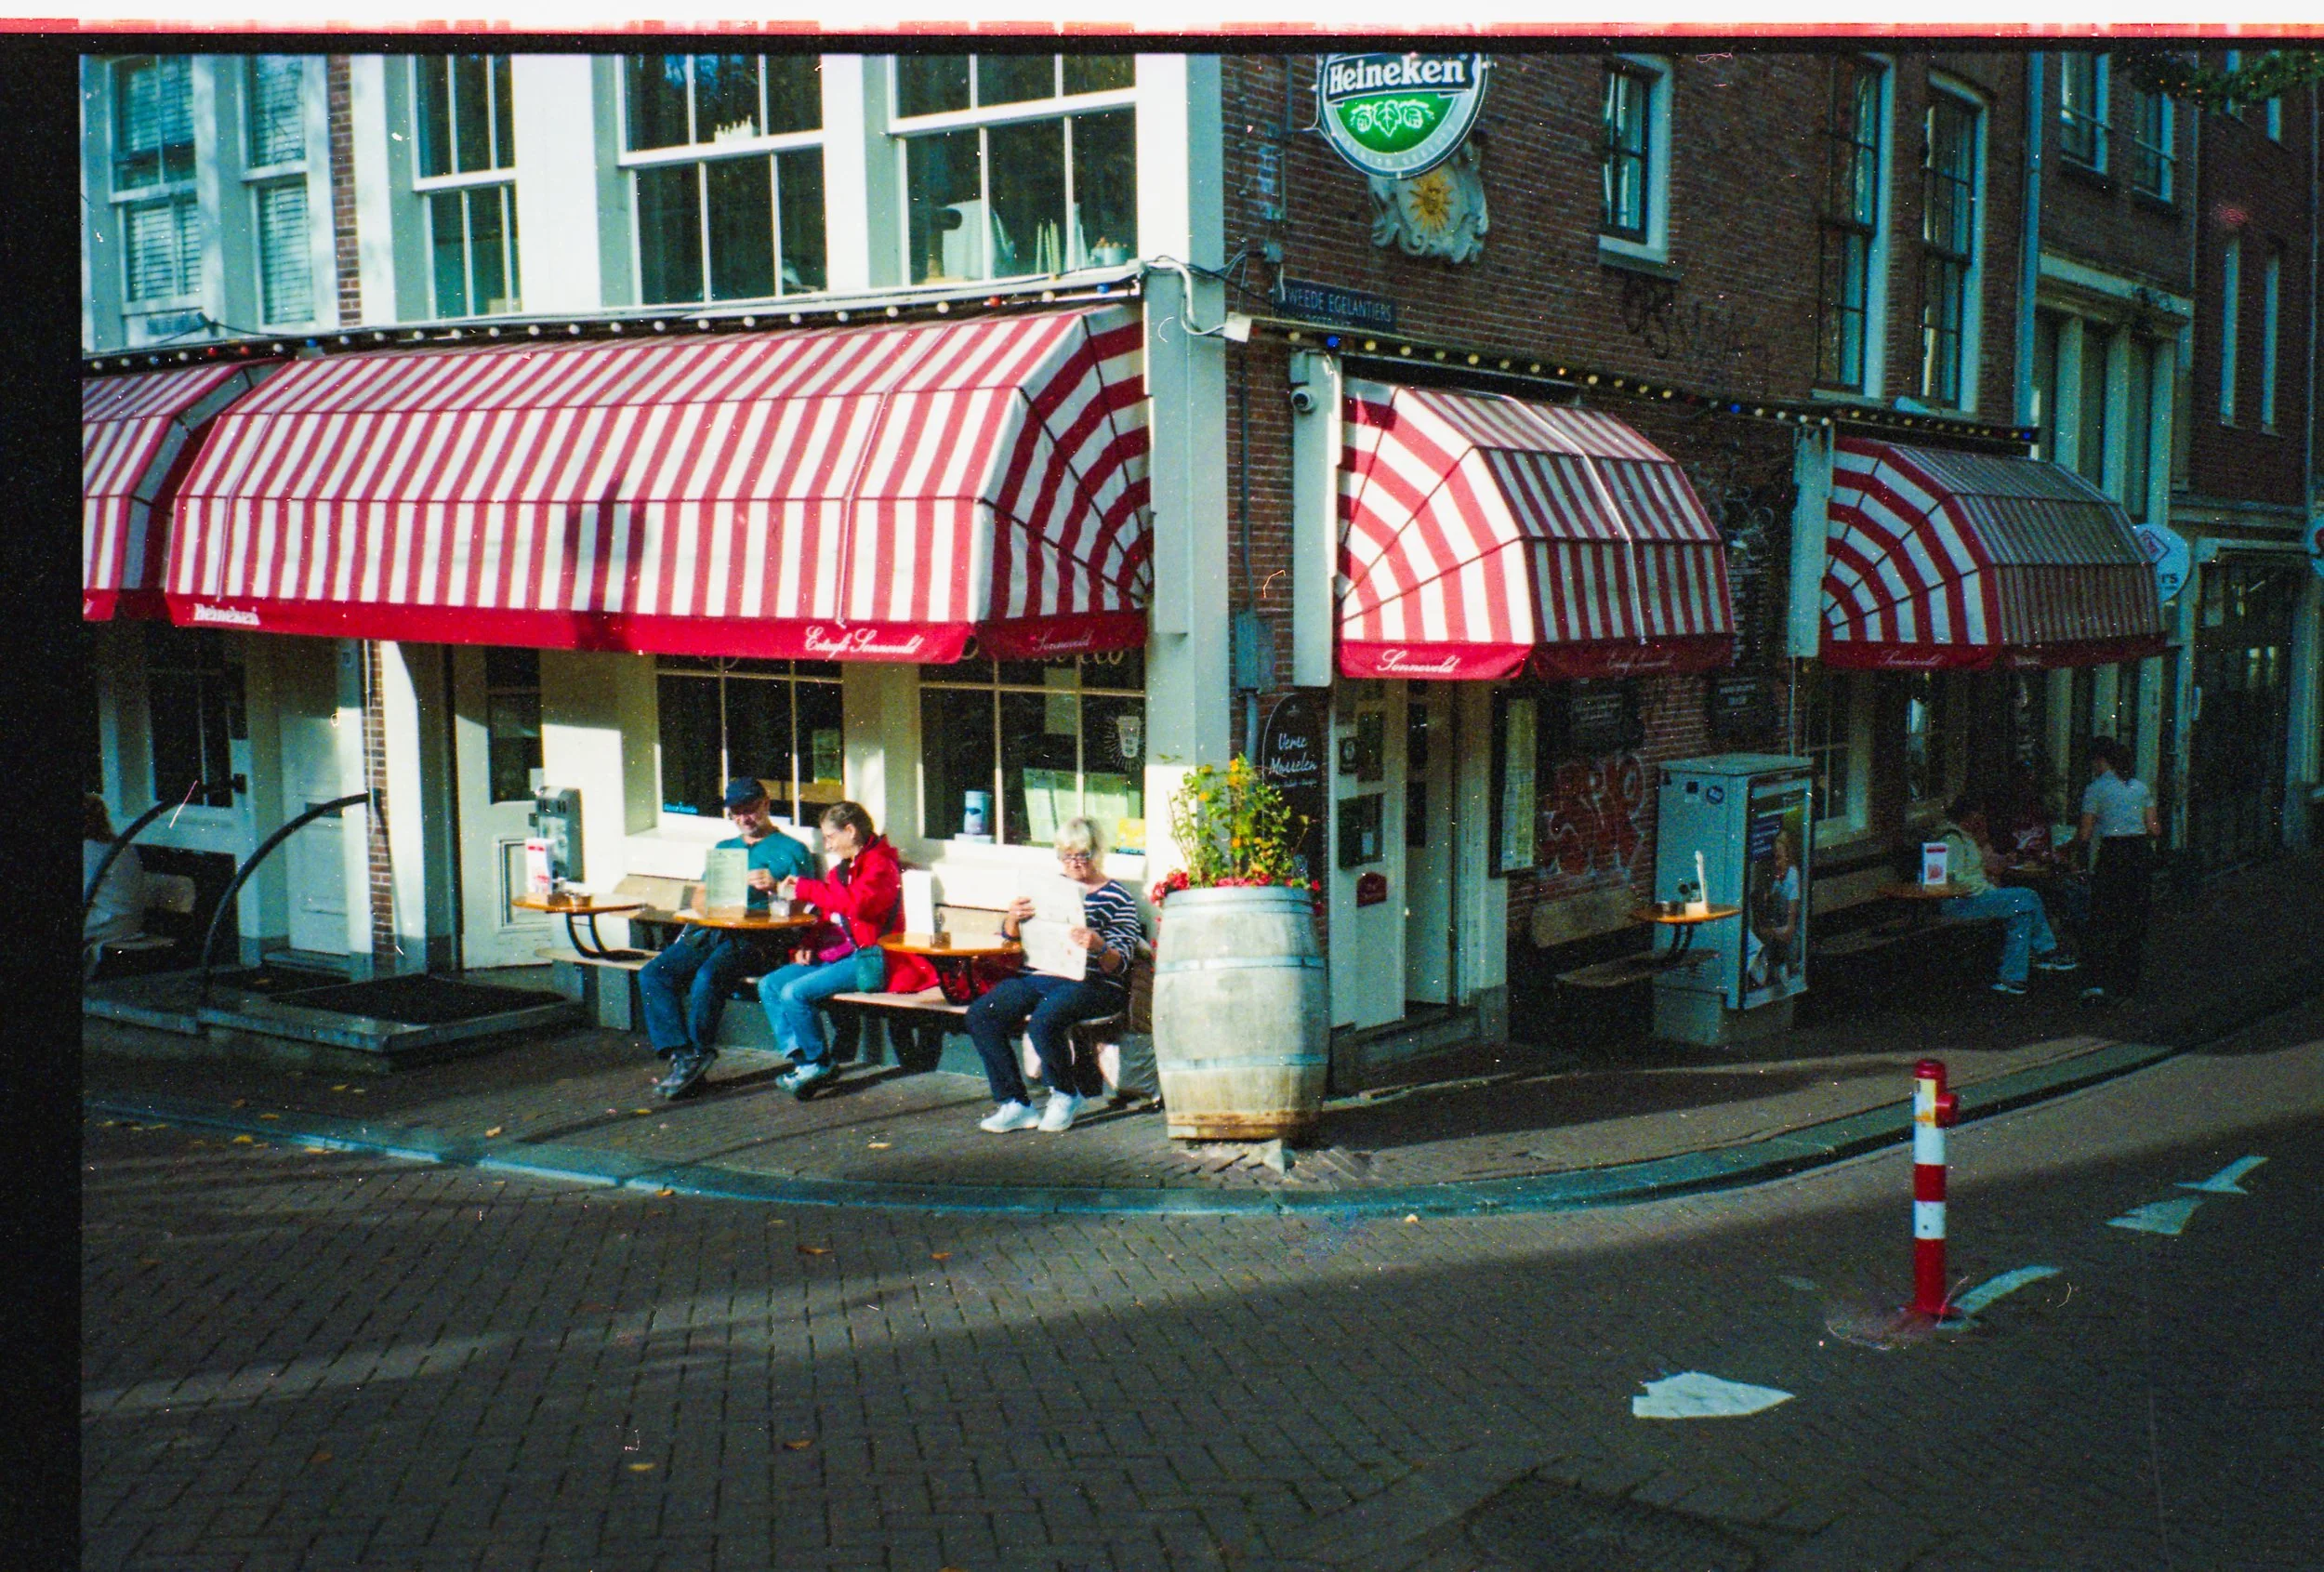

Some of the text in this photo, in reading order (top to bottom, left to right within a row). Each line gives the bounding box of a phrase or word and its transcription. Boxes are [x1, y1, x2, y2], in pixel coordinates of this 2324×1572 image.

[1328, 54, 1466, 95] Heineken
[1286, 286, 1325, 310] WEEDE
[192, 601, 261, 627] Heineken
[1376, 648, 1461, 674] Sonneveld
